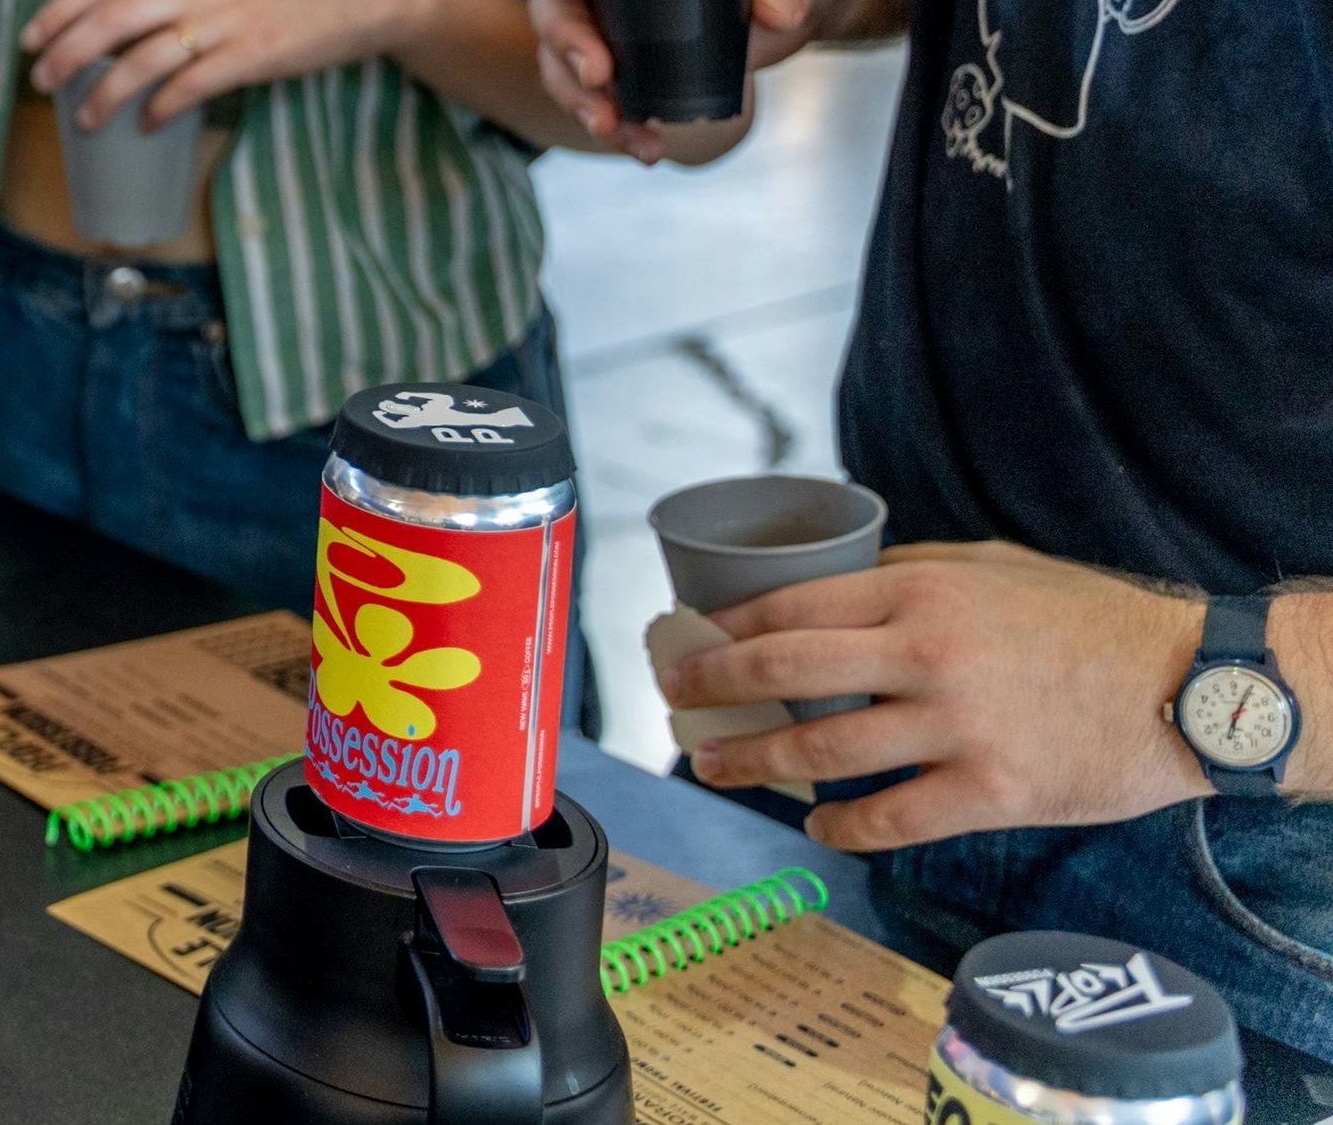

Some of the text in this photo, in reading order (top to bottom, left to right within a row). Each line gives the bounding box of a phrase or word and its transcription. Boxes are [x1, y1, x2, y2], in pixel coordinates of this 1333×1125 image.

[524, 636, 533, 664] COFFEE
[520, 690, 529, 712] WAVE
[519, 712, 527, 731] NEW
